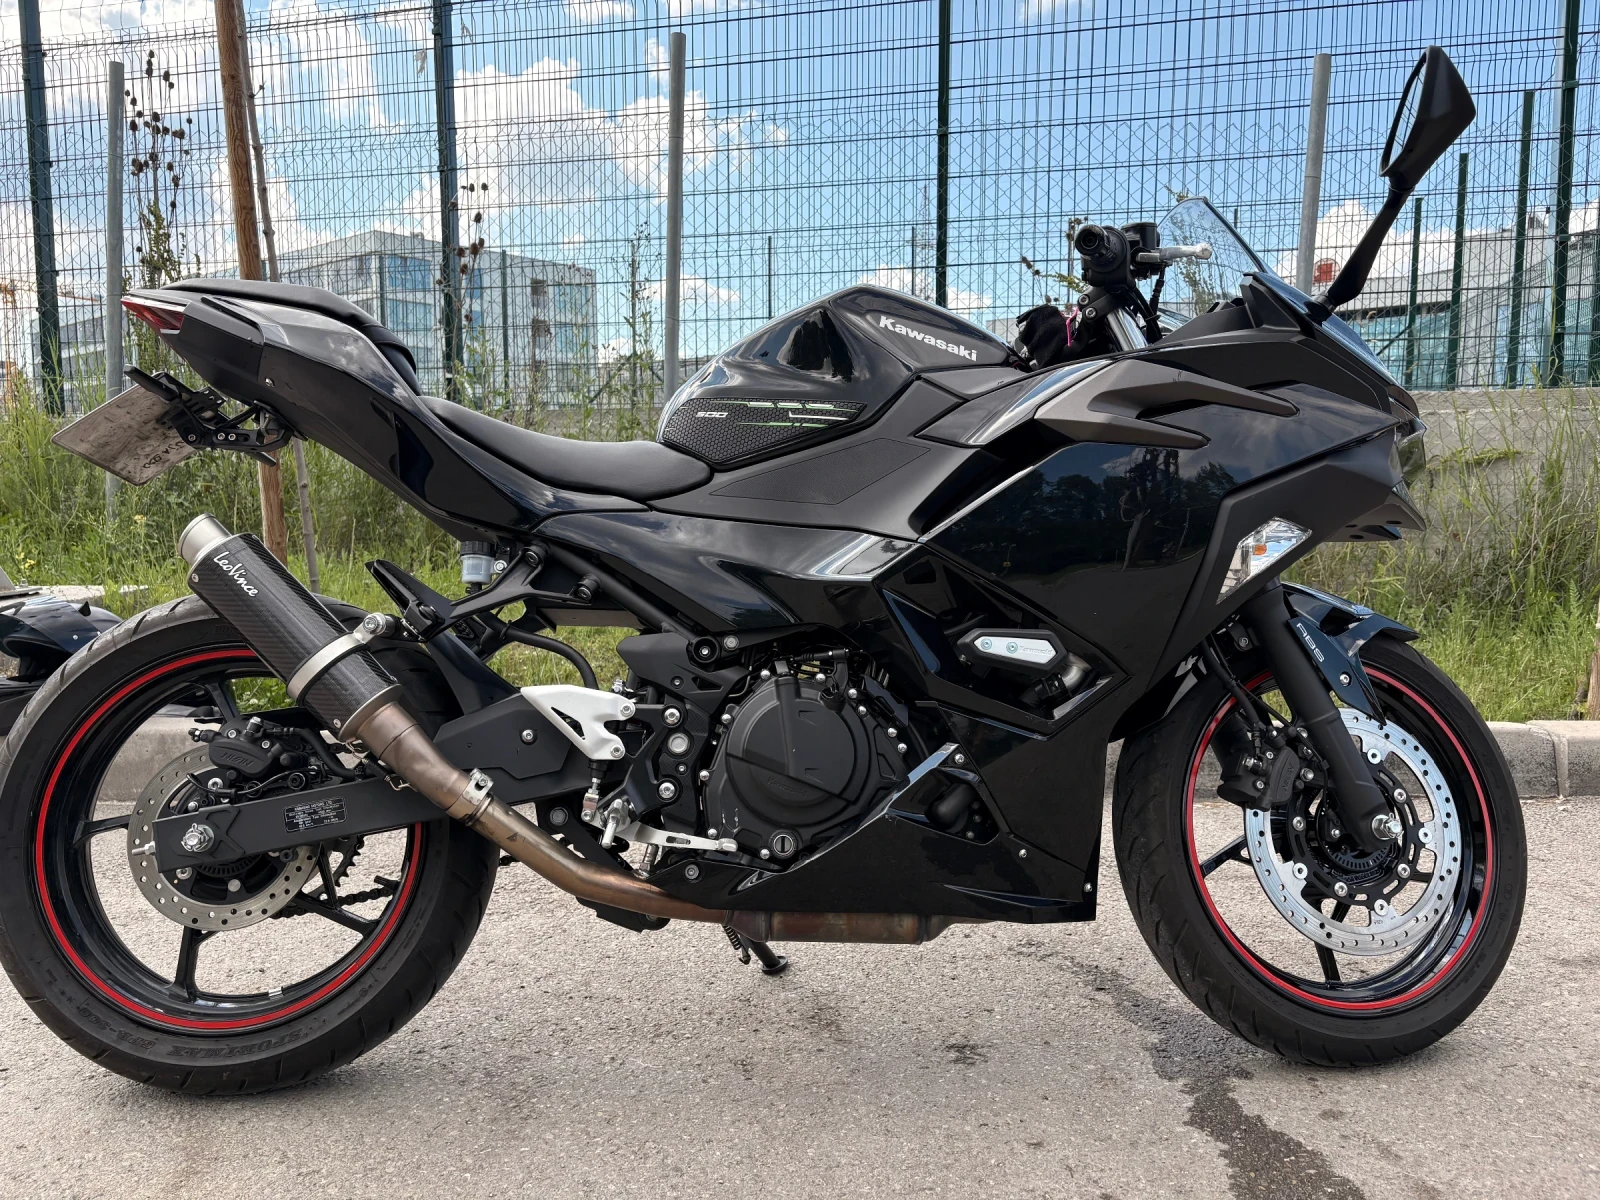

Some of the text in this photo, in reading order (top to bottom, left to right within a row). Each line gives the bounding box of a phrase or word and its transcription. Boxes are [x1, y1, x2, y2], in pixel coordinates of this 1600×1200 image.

[879, 315, 978, 362] Kawasaki
[213, 551, 259, 597] LeoVince
[1296, 622, 1325, 662] ABS
